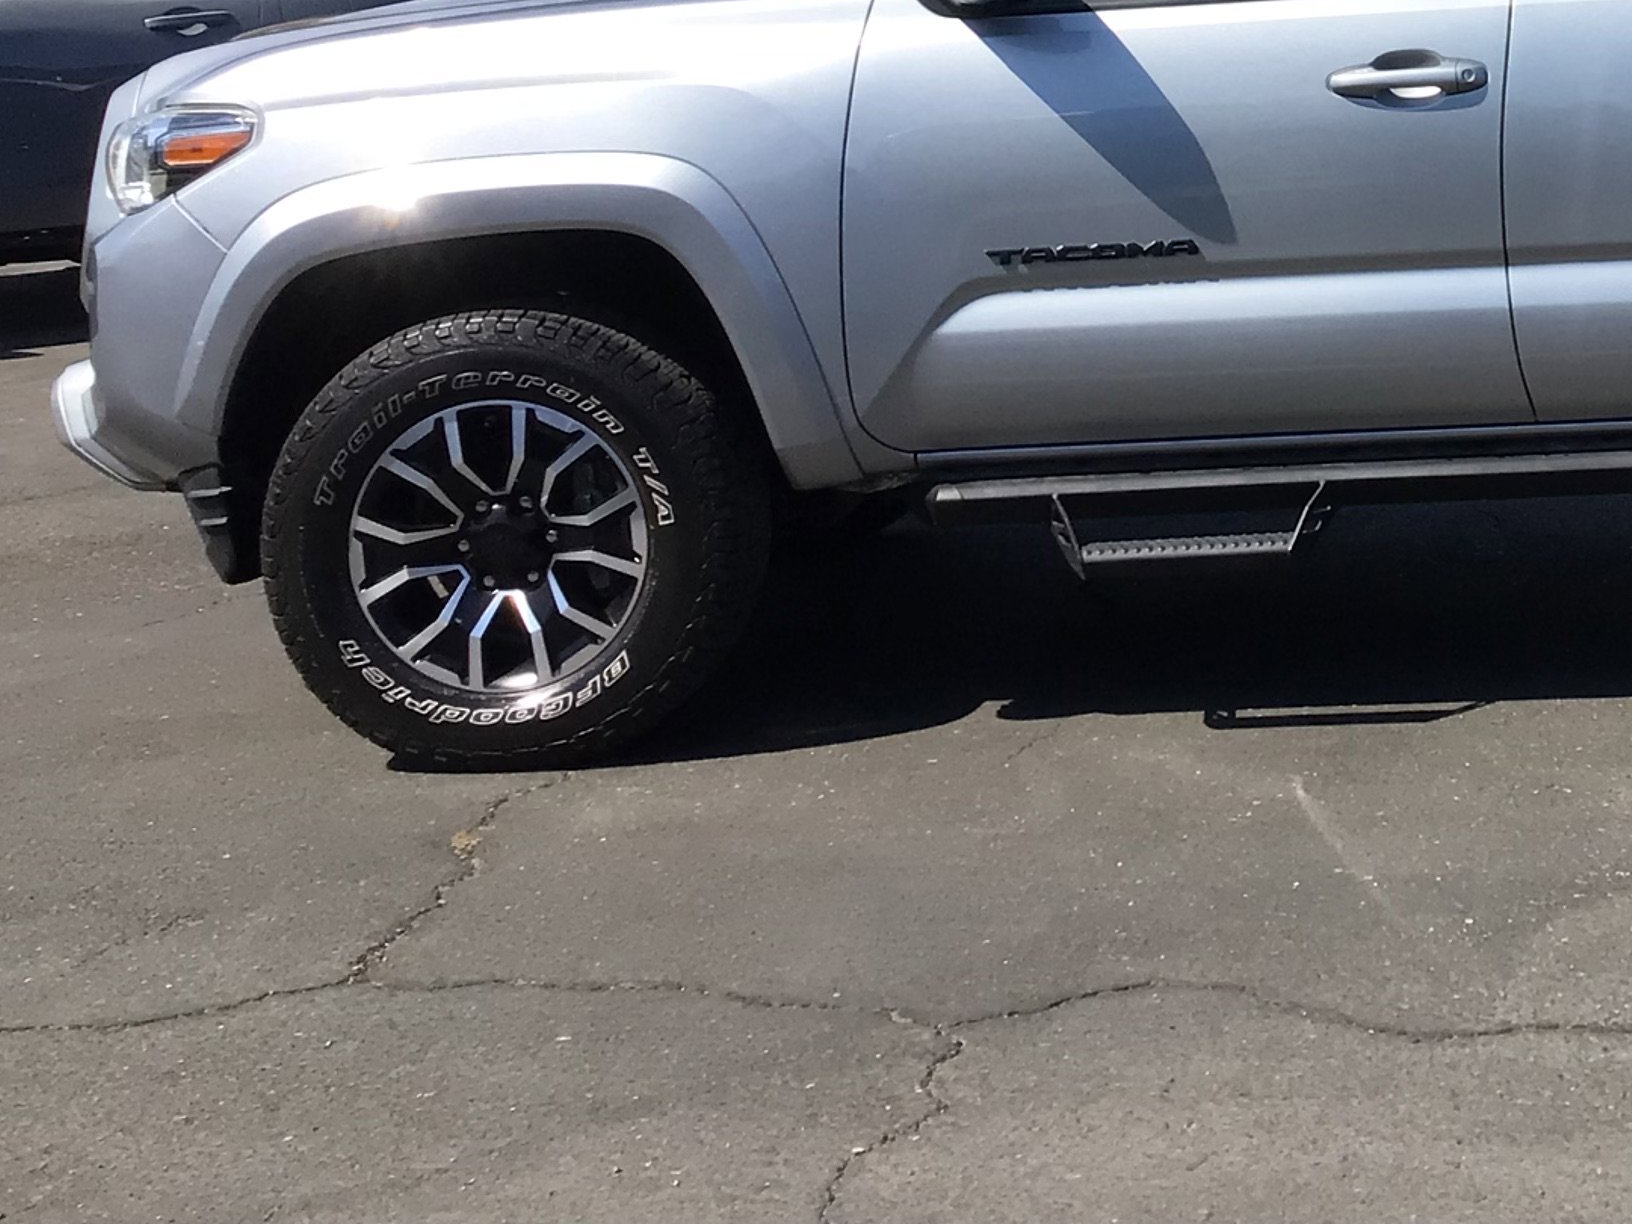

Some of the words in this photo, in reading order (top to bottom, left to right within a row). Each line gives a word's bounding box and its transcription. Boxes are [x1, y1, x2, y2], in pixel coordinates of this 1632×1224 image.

[984, 239, 1200, 266] TACOMA
[313, 369, 625, 508] Trail-Terrain
[632, 447, 676, 527] T/A
[338, 638, 631, 726] BFGoodrich
